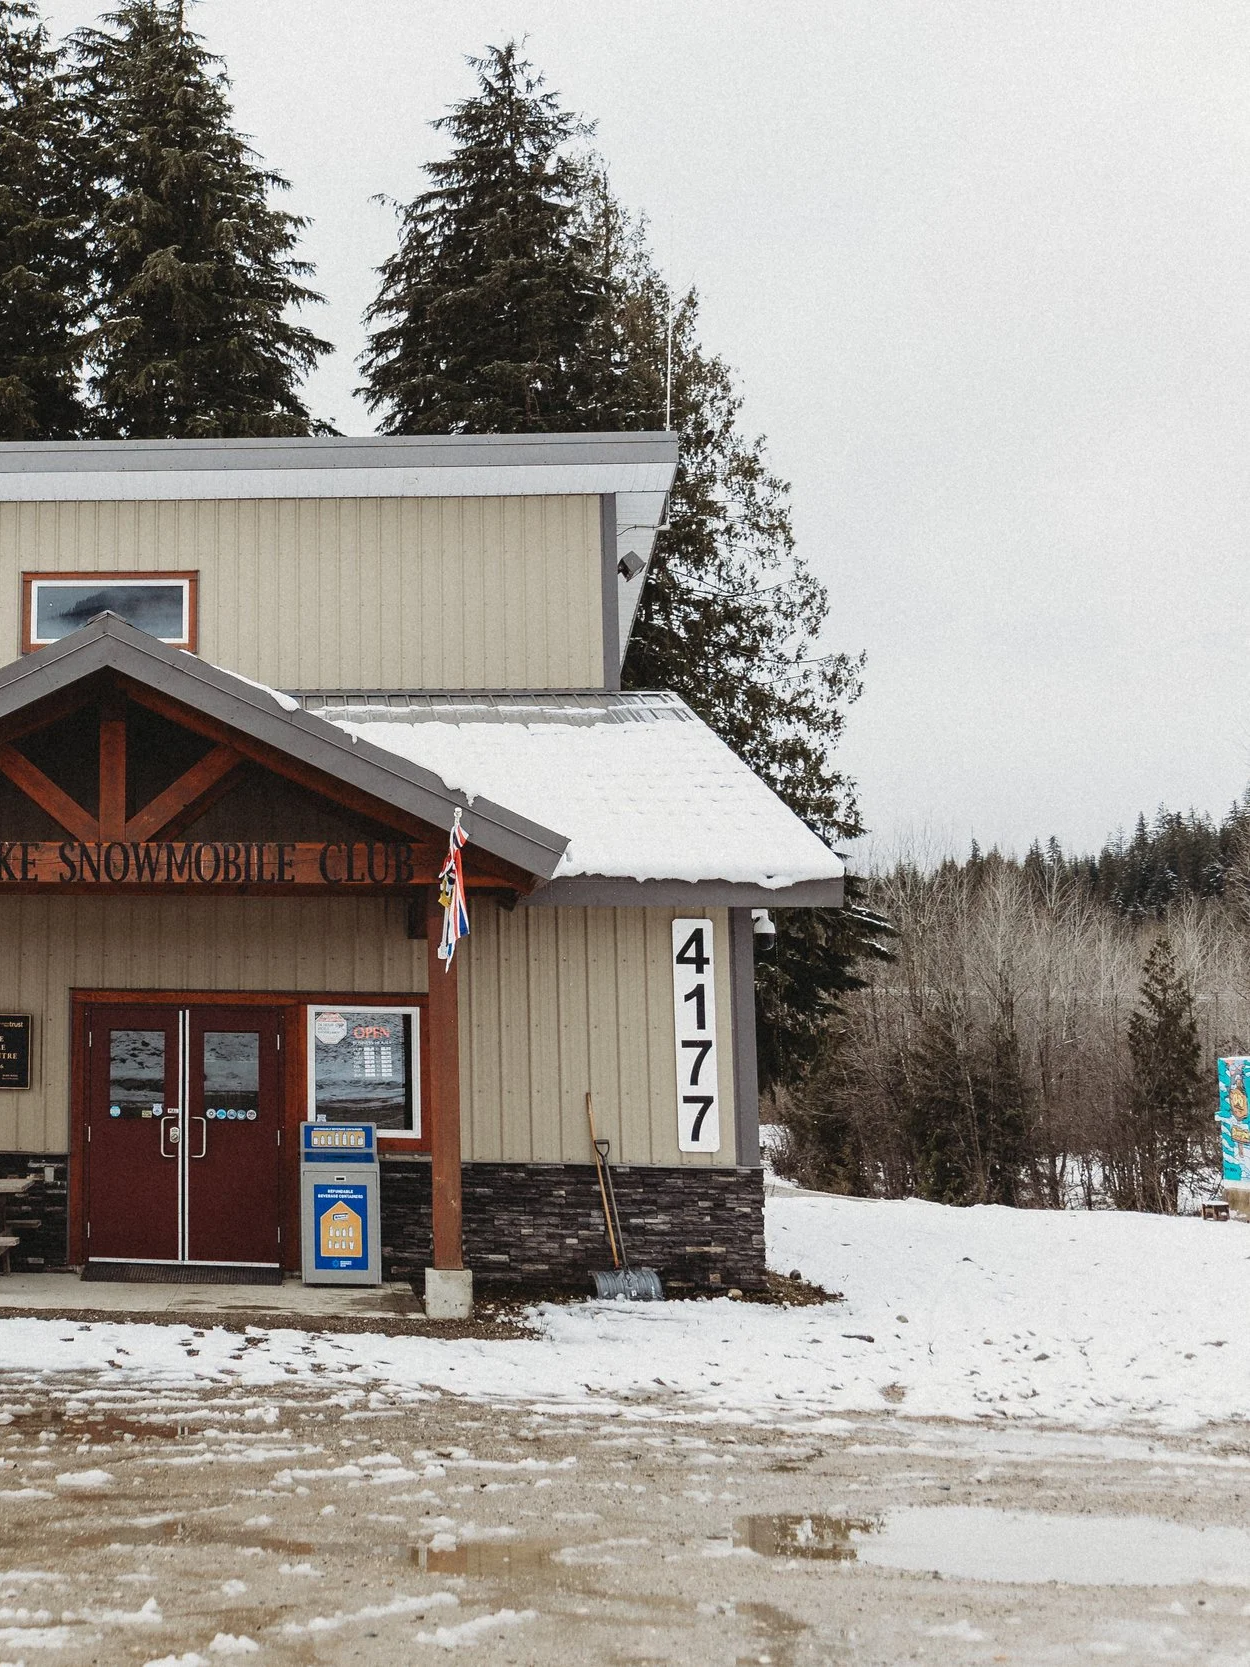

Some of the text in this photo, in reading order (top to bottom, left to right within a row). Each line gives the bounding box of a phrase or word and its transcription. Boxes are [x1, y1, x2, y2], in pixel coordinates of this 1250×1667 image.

[59, 841, 295, 884] SNOWMOBILE
[319, 842, 414, 884] CLUB
[352, 1026, 390, 1039] OPEN
[675, 927, 714, 1142] 4177
